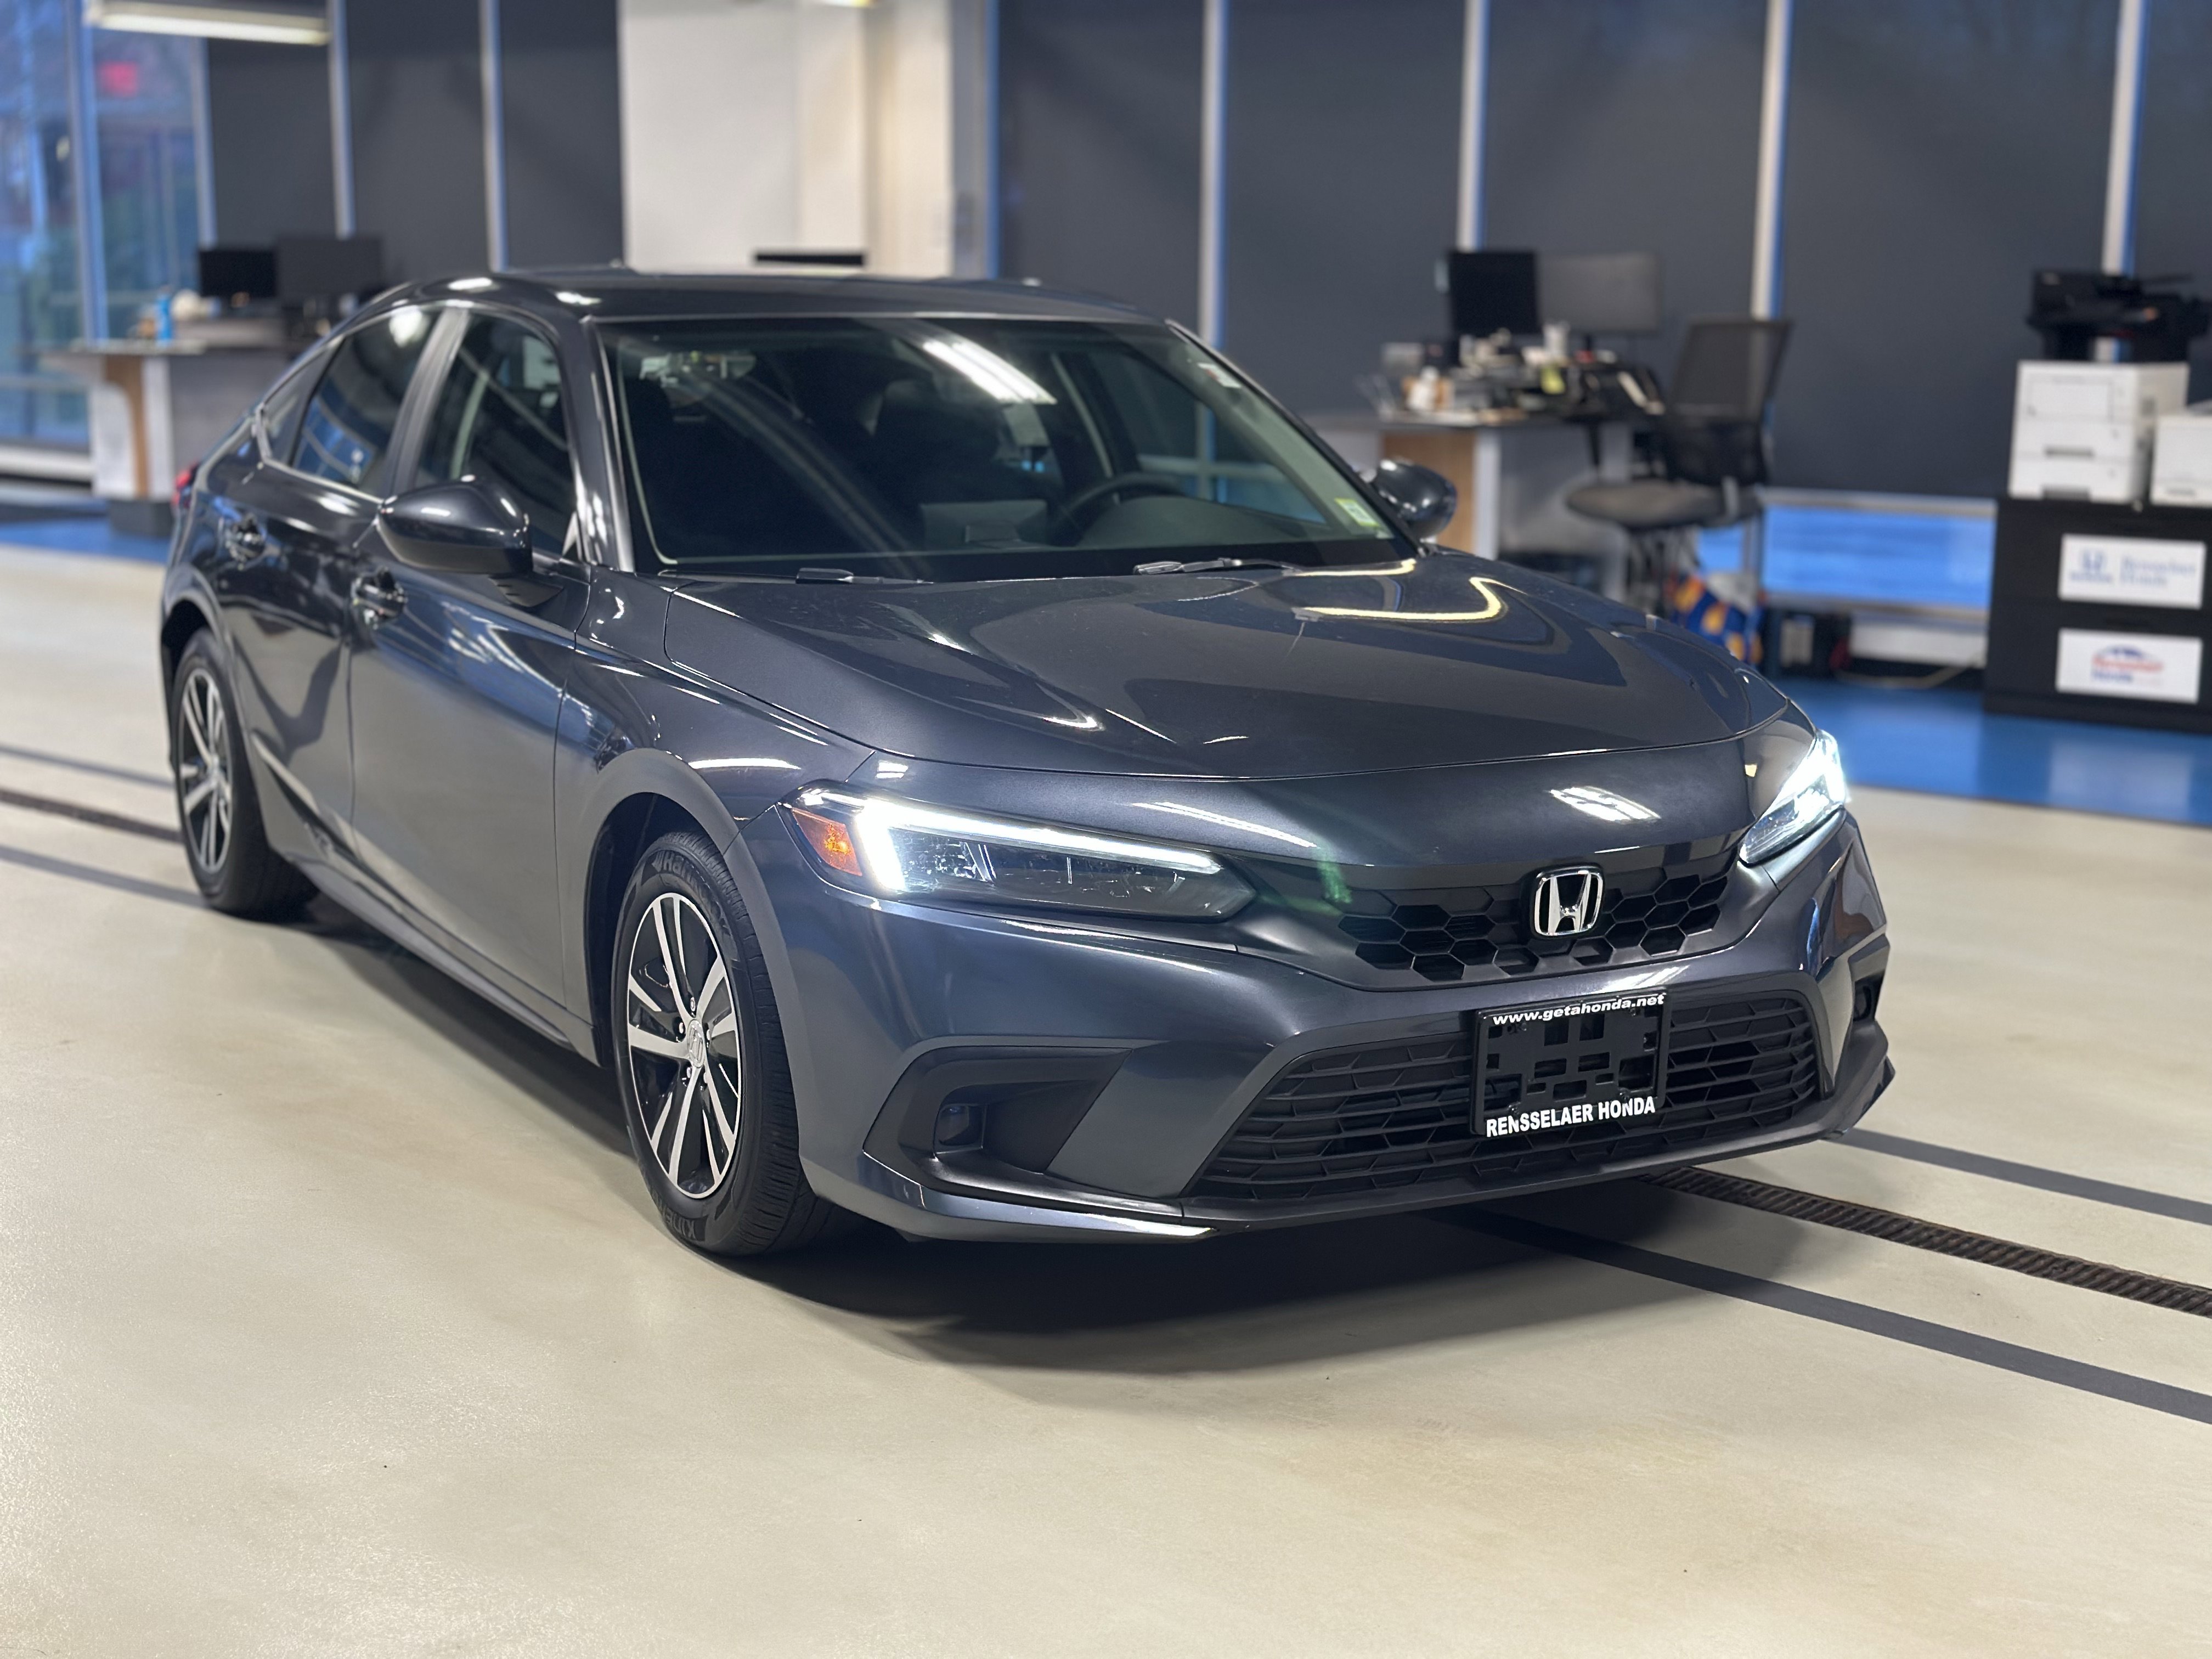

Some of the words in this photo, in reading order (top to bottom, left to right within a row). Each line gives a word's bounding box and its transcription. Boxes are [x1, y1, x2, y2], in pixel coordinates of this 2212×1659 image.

[1492, 994, 1664, 1025] www.getahonda.net
[1486, 1104, 1594, 1137] RENSSELAER
[1598, 1096, 1656, 1120] HONDA
